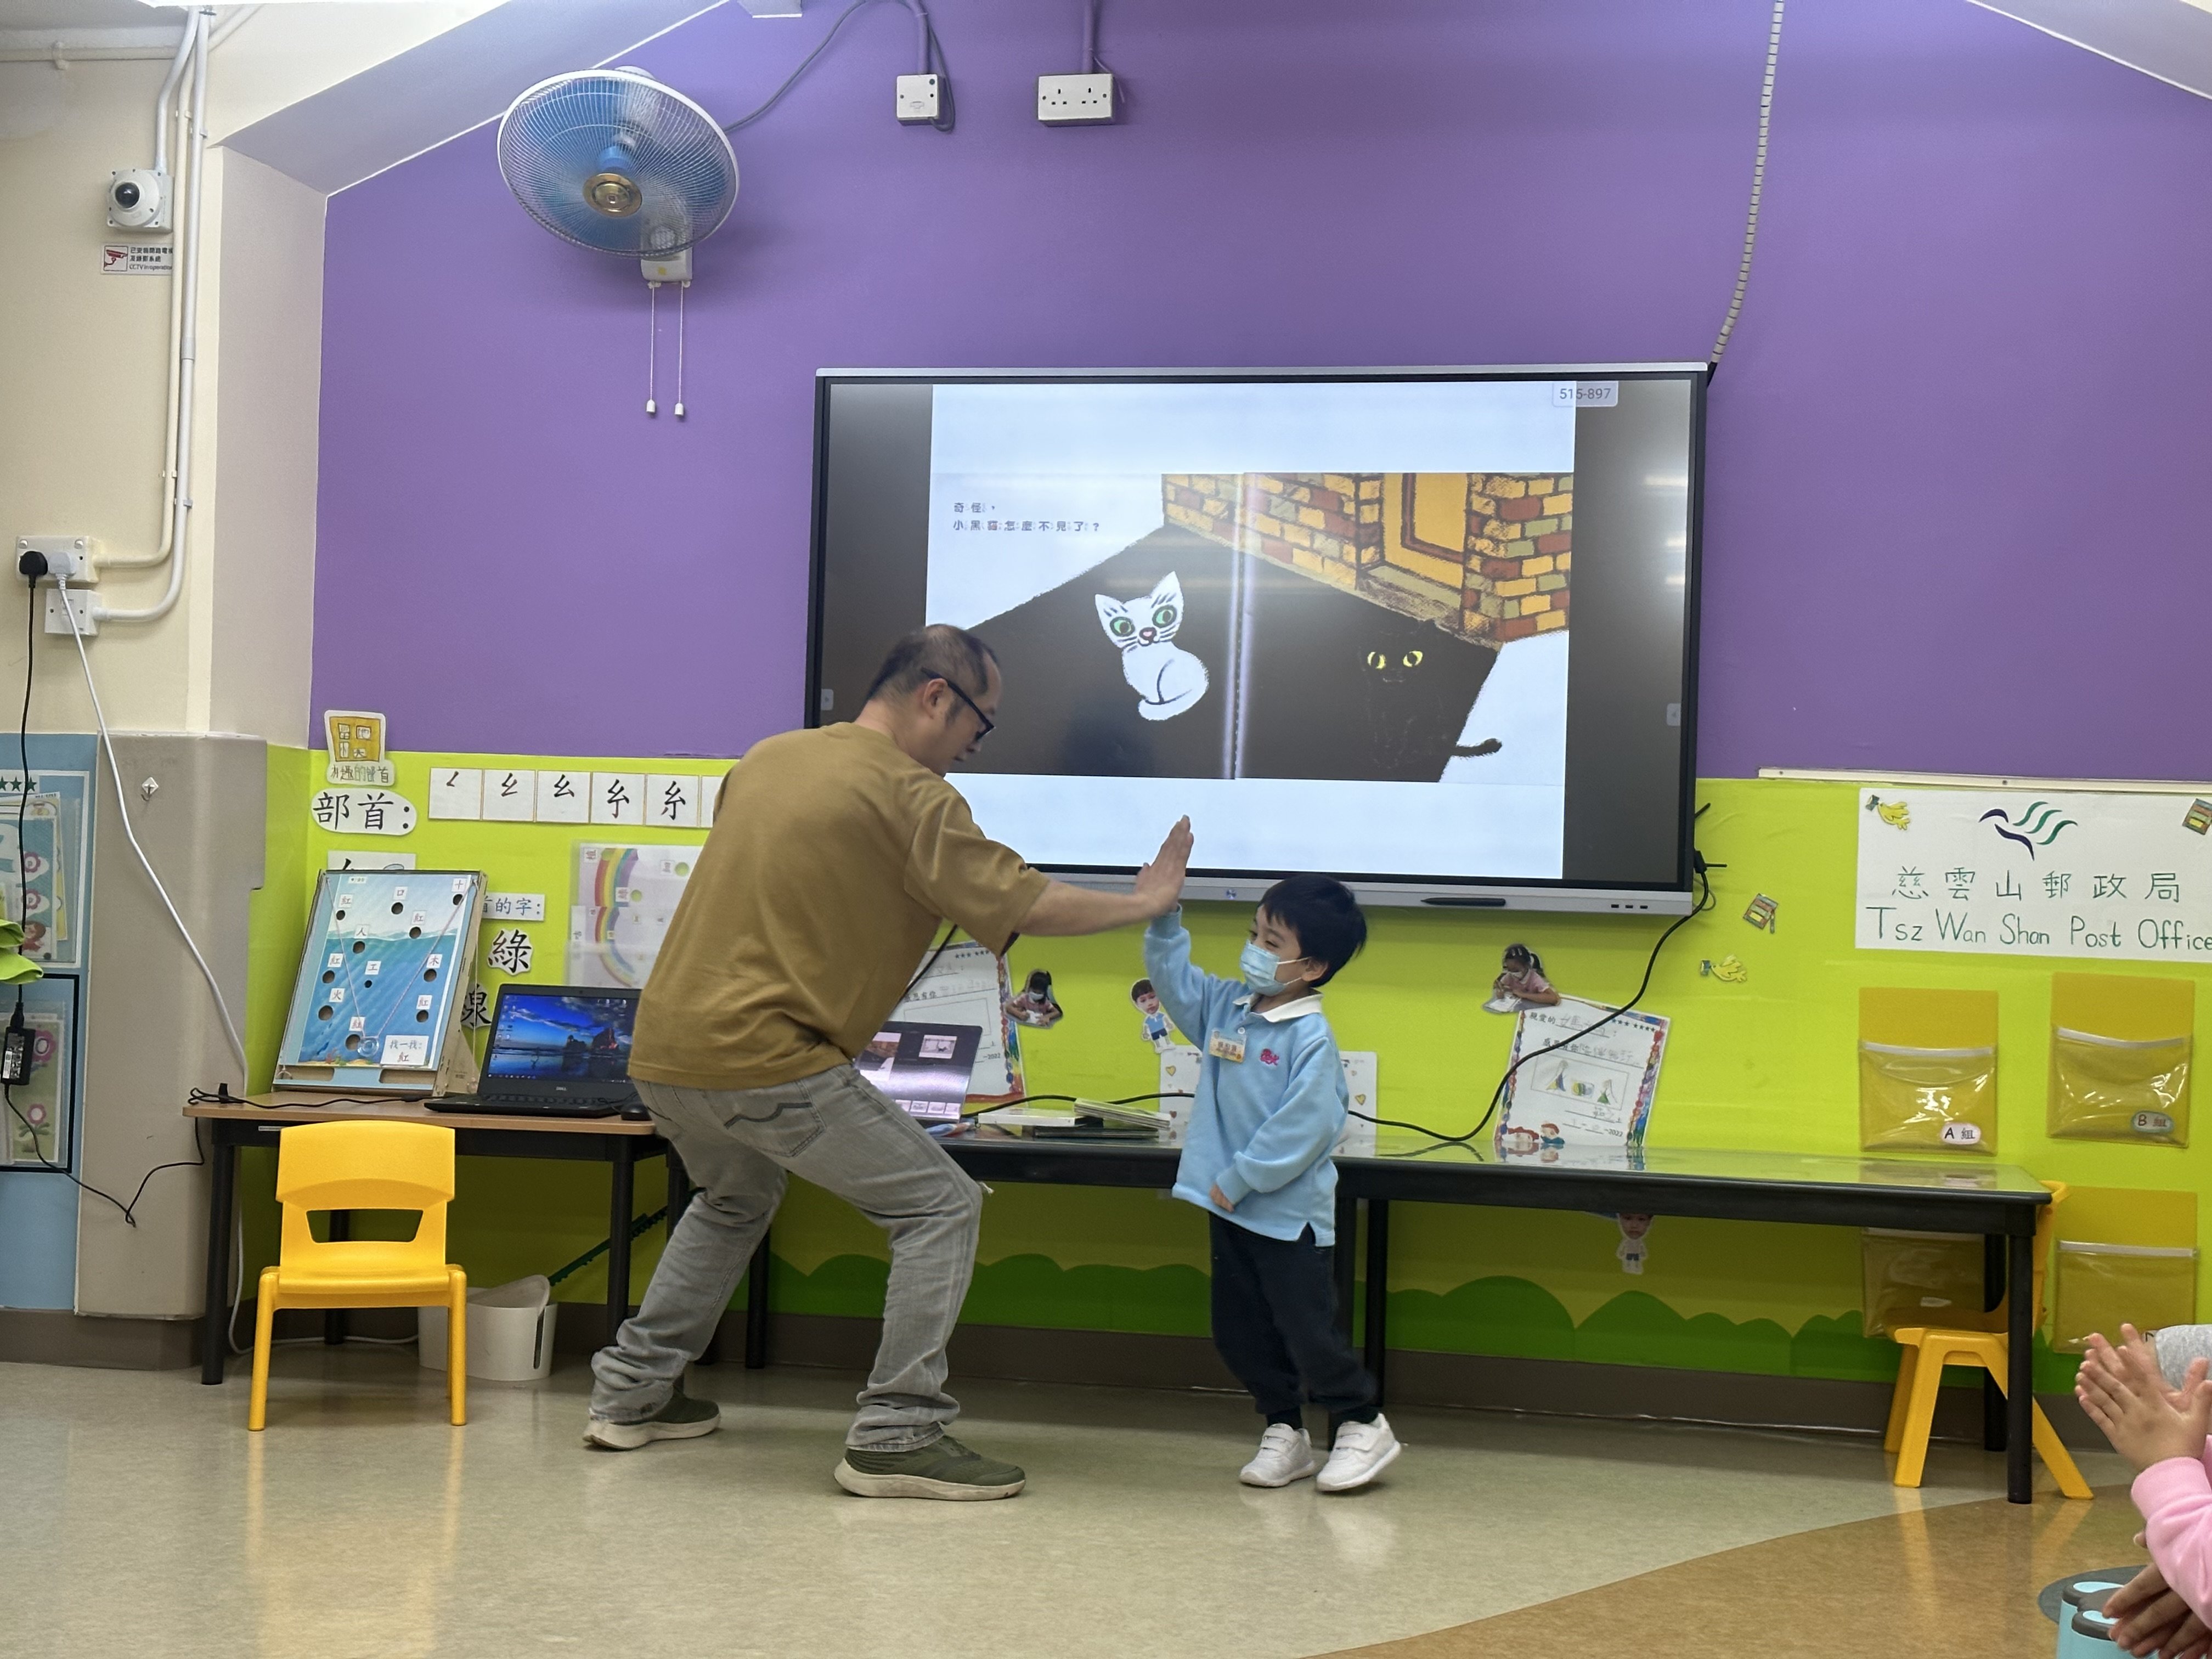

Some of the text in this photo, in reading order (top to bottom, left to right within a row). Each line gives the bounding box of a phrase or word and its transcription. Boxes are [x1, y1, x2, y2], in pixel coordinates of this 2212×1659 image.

[1560, 388, 1611, 399] 515-897
[455, 879, 464, 890] 十
[1892, 866, 2180, 903] 慈雲山郵政局
[357, 927, 366, 936] 人
[1866, 906, 2212, 950] Tsz Wan Shan Post Office
[488, 929, 532, 973] 綠
[430, 956, 439, 967] 木
[368, 963, 378, 972] 工
[332, 990, 342, 1001] 火
[397, 1052, 409, 1063] 紅
[2137, 1114, 2147, 1126] B
[1944, 1127, 1974, 1141] A 組
